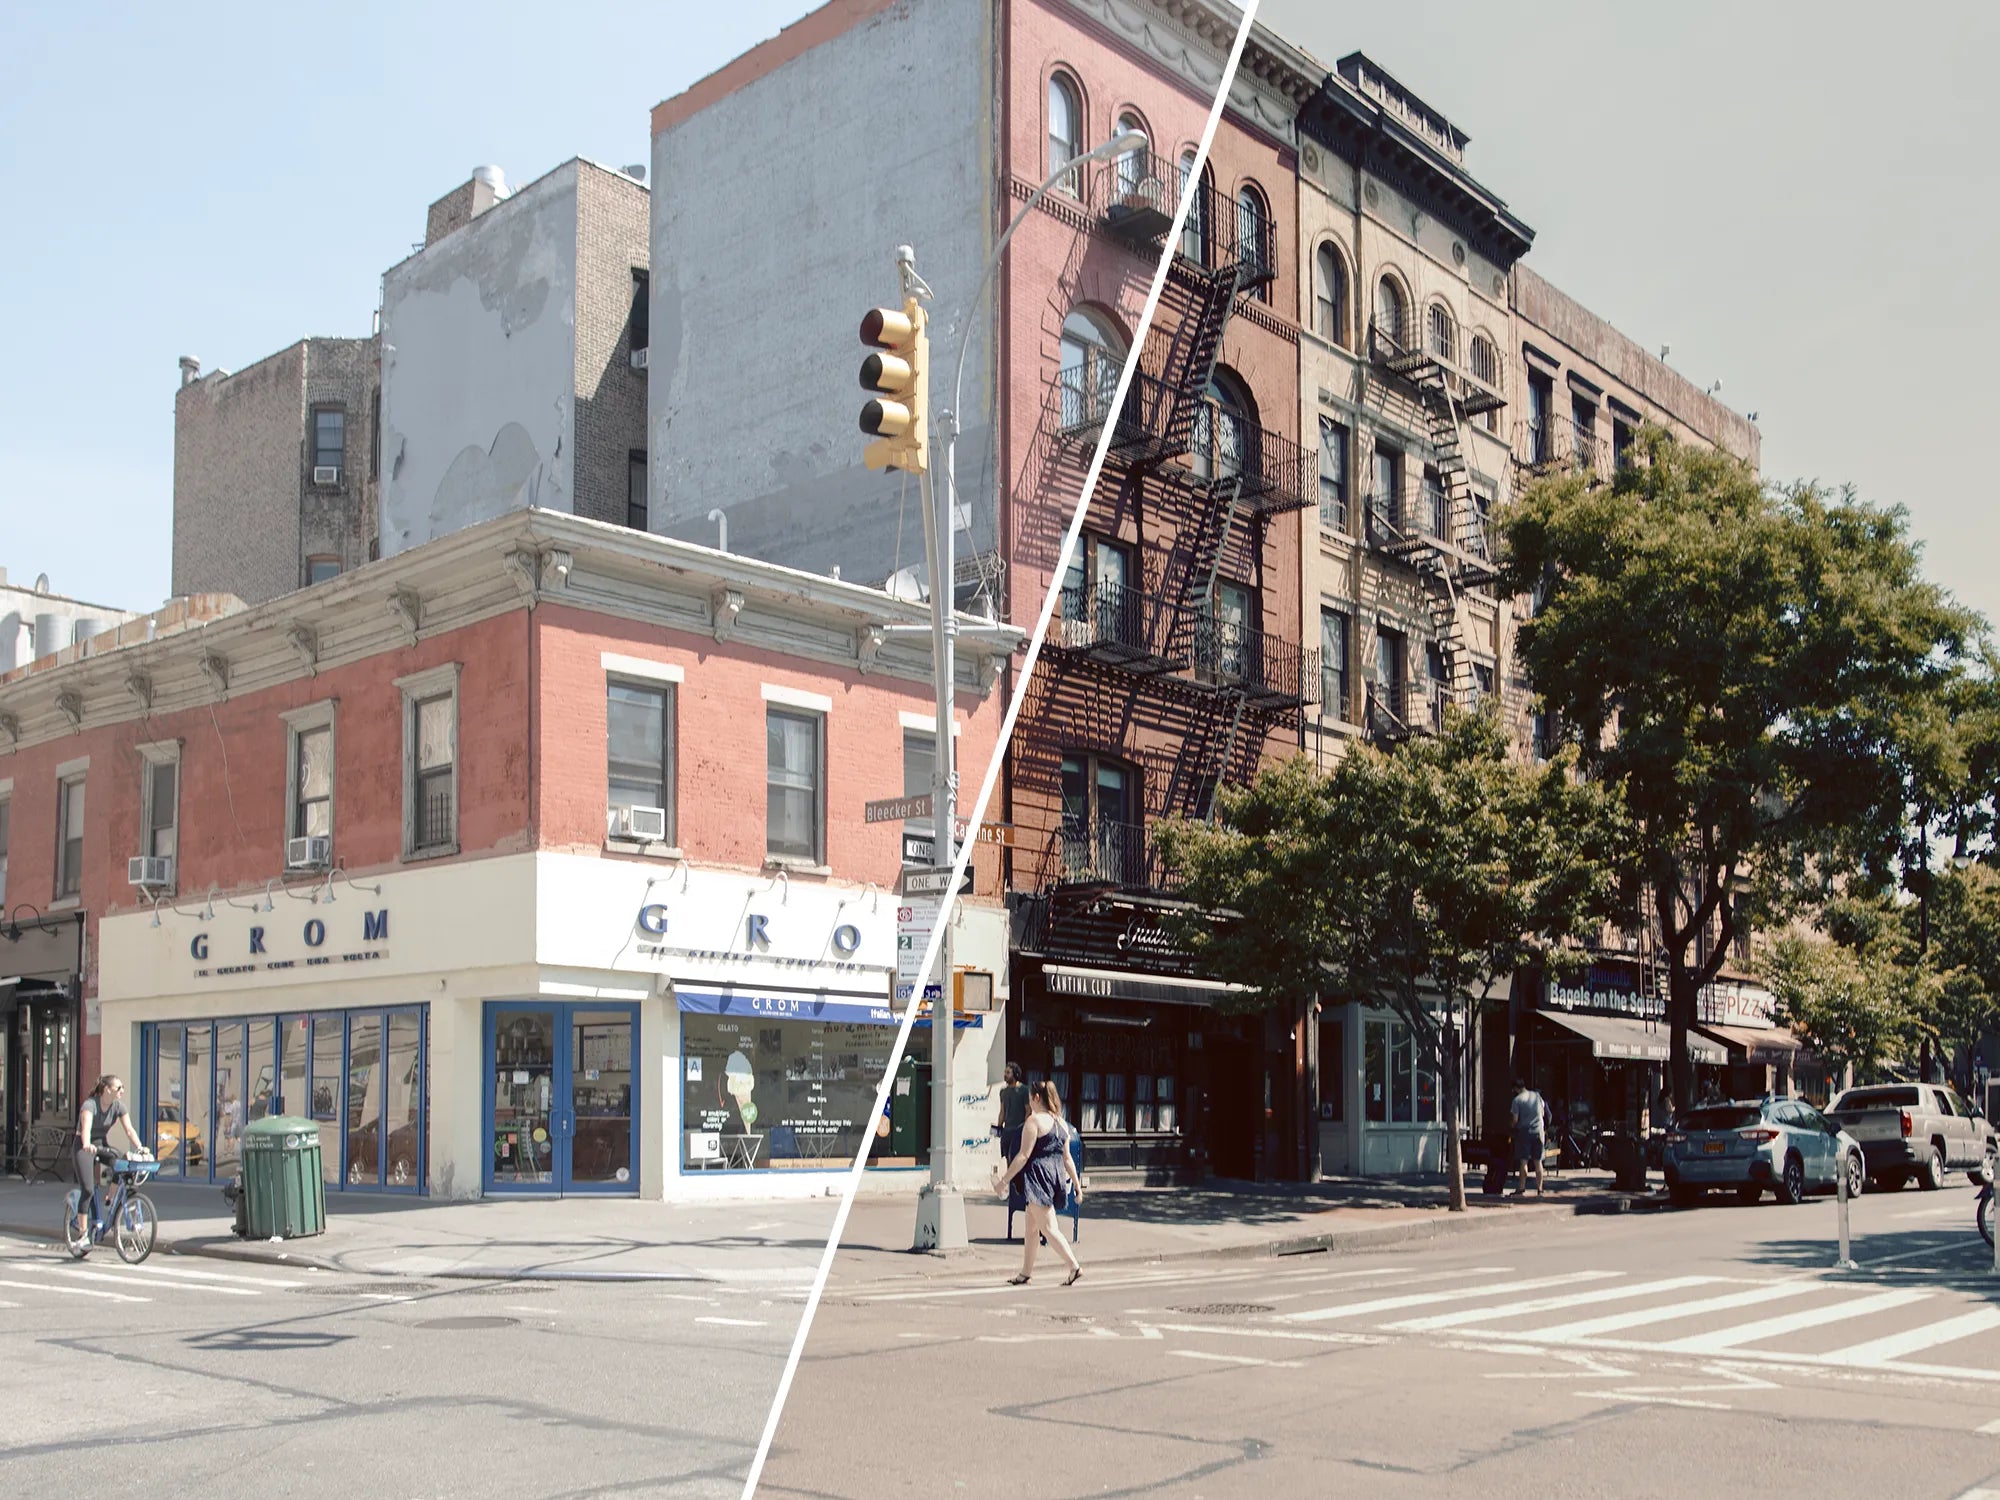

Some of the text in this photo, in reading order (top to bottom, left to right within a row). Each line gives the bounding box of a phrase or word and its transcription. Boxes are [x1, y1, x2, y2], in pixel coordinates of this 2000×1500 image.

[866, 799, 926, 821] Bleecker St
[995, 827, 1005, 845] St
[911, 876, 930, 889] ONE
[190, 909, 389, 961] GROM
[638, 904, 862, 952] GRO
[901, 936, 909, 949] 2
[1051, 974, 1112, 996] CANTINA CLUB
[752, 998, 799, 1012] GROM
[1550, 981, 1666, 1018] Bagels on the Square
[1727, 995, 1771, 1019] PIZZA
[717, 1023, 739, 1033] GELATO
[690, 1060, 699, 1073] A
